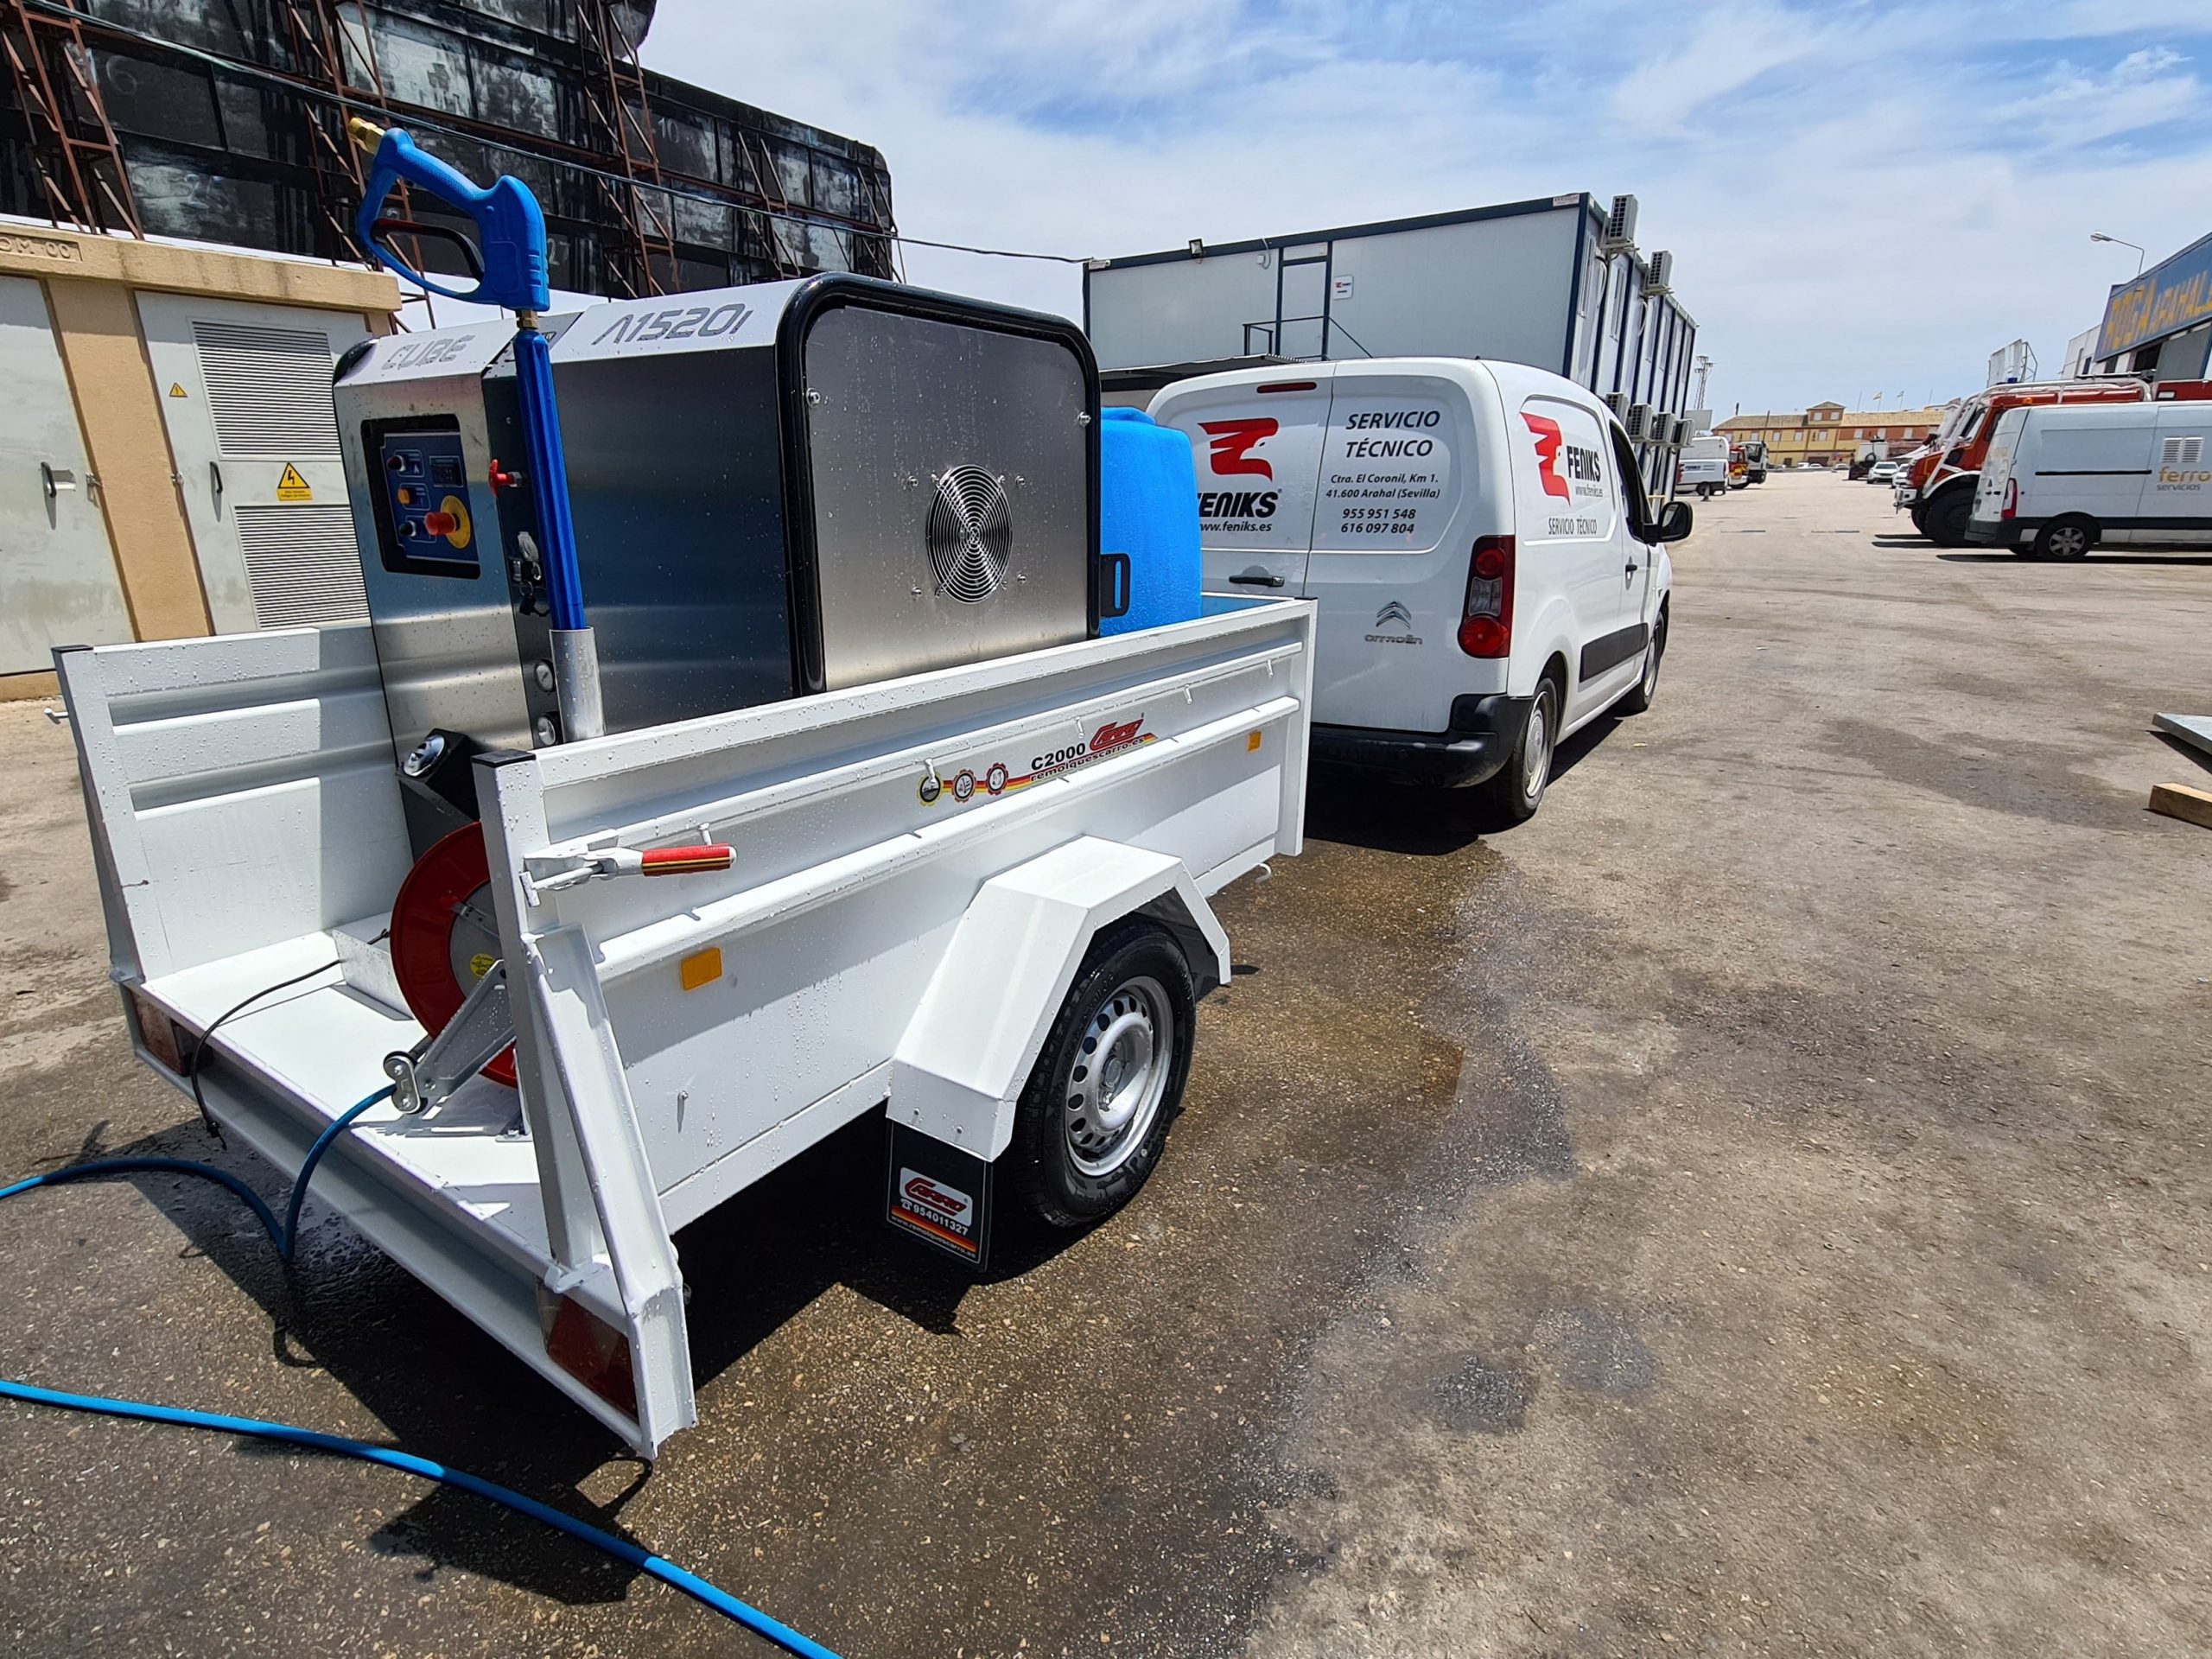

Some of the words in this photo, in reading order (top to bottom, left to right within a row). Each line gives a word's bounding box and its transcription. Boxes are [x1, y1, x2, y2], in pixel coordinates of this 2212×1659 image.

[1345, 410, 1441, 430] SERVICIO
[1345, 437, 1433, 458] TÉCNICO
[1567, 445, 1601, 483] FENIKS
[1331, 474, 1354, 484] Ctra.
[1356, 474, 1367, 483] El
[1367, 473, 1407, 485] Coronil,
[1409, 473, 1427, 483] Km
[1430, 474, 1440, 483] 1.
[1325, 489, 1360, 499] 41.600
[1360, 488, 1396, 499] Arahal
[1397, 488, 1441, 499] (Sevilla)
[1198, 491, 1279, 518] ENIKS
[1342, 508, 1365, 519] 955
[1367, 509, 1389, 519] 951
[1392, 508, 1417, 519] 548
[1199, 521, 1272, 531] ww.feniks.es
[1340, 523, 1363, 533] 616
[1365, 523, 1390, 533] 097
[1390, 523, 1415, 534] 804
[1548, 518, 1574, 535] SERVICIO
[1577, 516, 1598, 535] TÉCNICO
[1029, 736, 1145, 782] remolquescarro.es
[1031, 742, 1086, 771] C2000
[912, 1204, 969, 1236] 954011327
